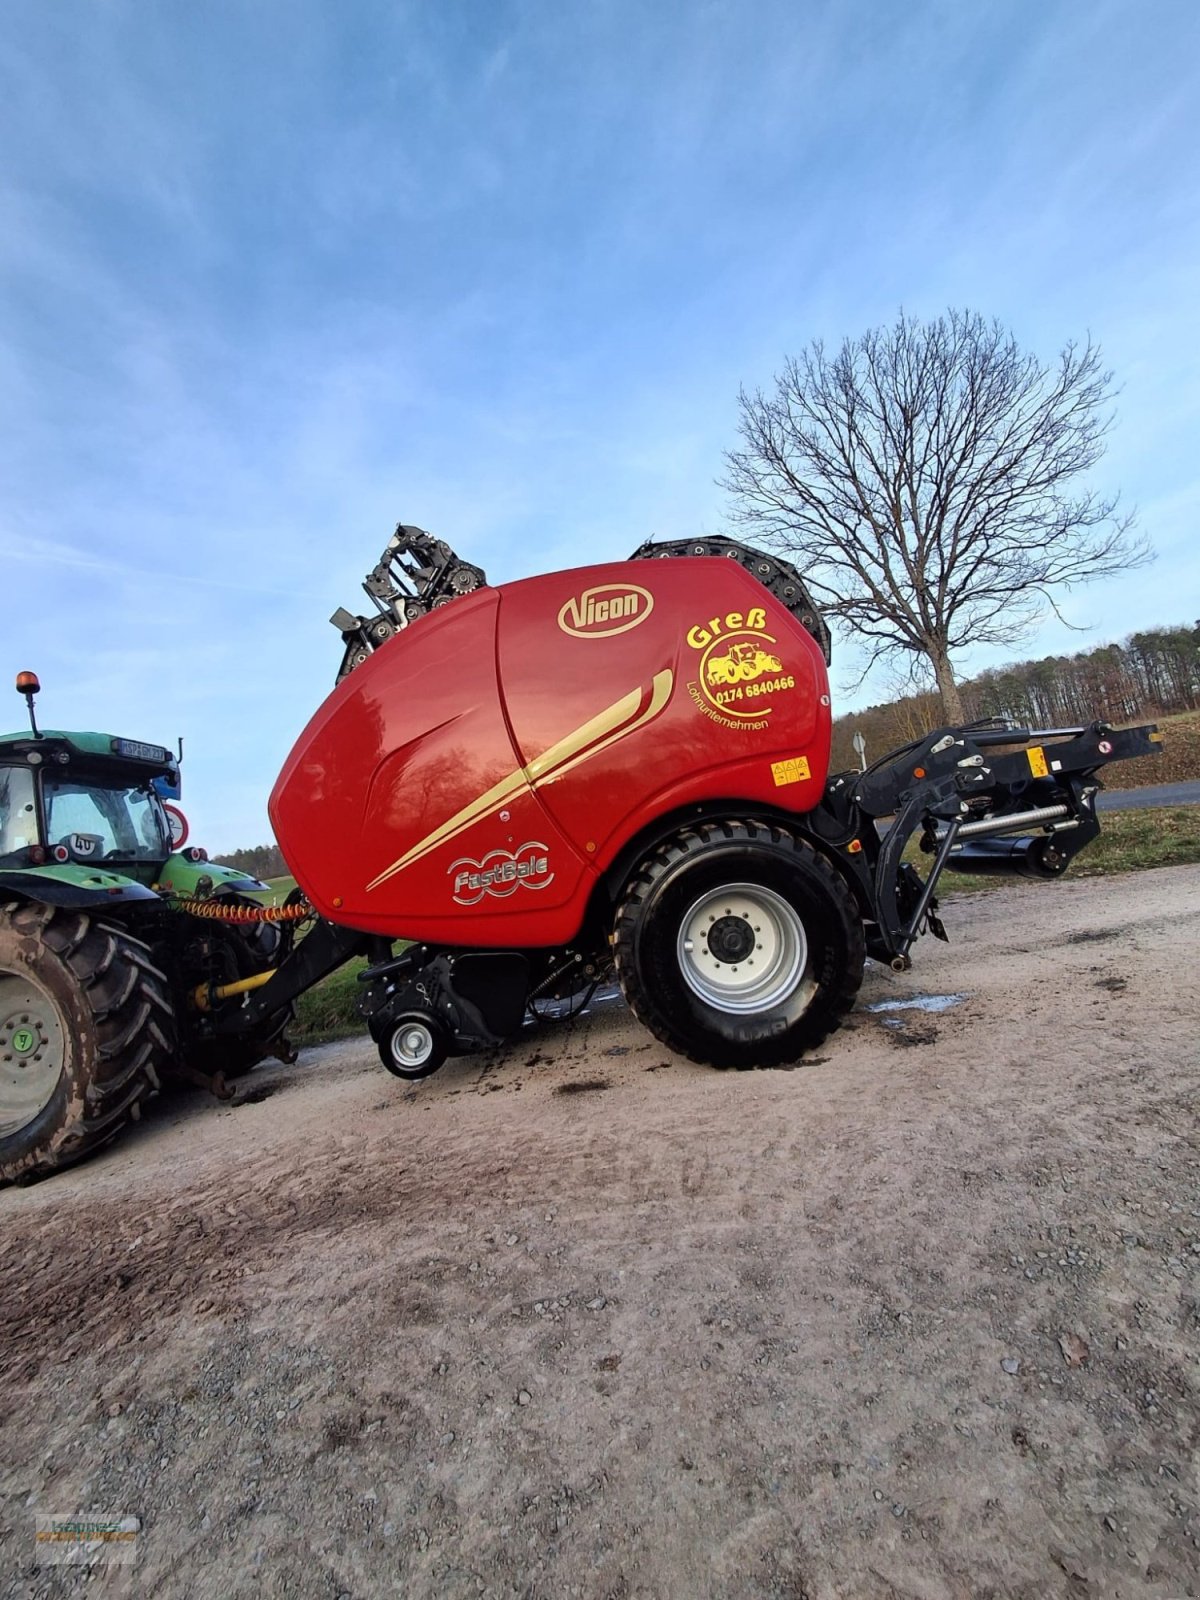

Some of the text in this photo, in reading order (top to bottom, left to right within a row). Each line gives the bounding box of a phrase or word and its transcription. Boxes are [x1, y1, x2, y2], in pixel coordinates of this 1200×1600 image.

[569, 591, 638, 628] Vicon
[686, 607, 766, 649] Greß
[686, 680, 769, 731] Lohnunternehmen
[716, 676, 795, 705] 0174 6840466
[75, 834, 91, 851] 40
[454, 855, 548, 894] FastBale
[19, 1034, 29, 1049] 7
